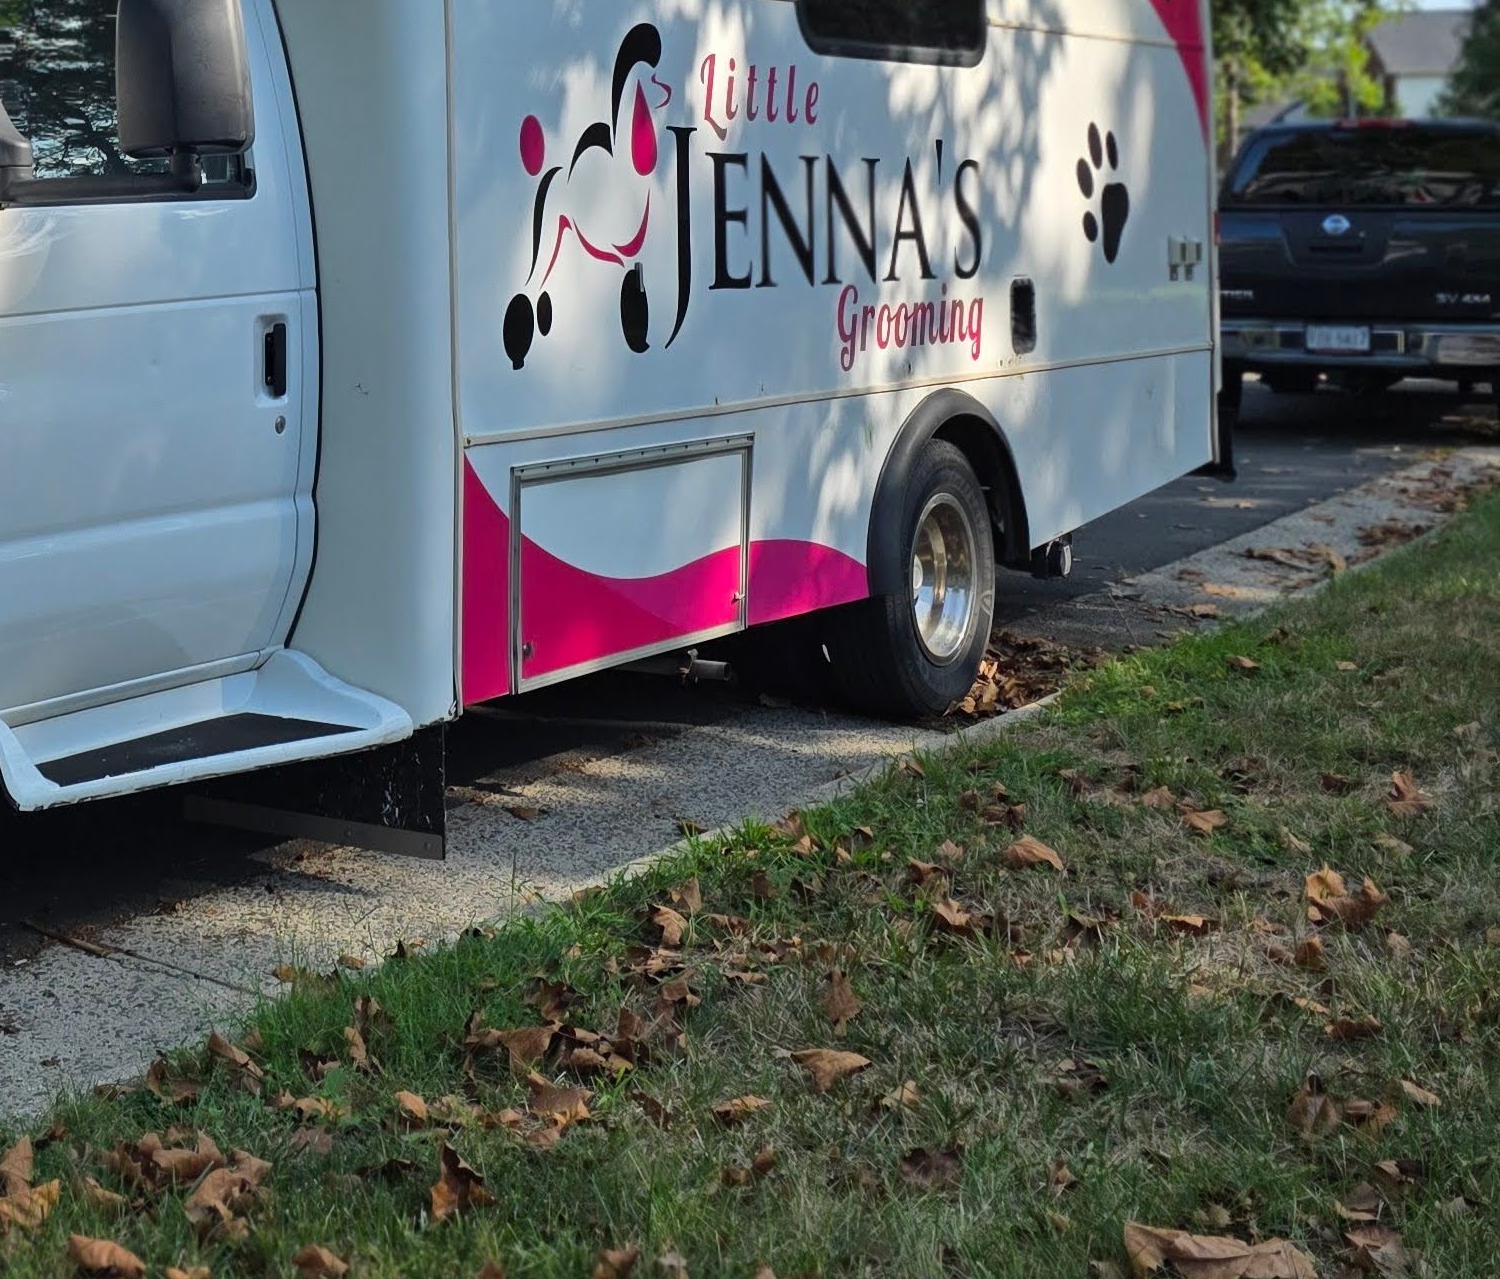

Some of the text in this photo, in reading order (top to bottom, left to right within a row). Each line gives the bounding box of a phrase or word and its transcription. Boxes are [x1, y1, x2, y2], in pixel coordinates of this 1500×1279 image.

[699, 52, 820, 142] Little
[664, 124, 984, 350] JENNA'S
[836, 283, 984, 373] Grooming
